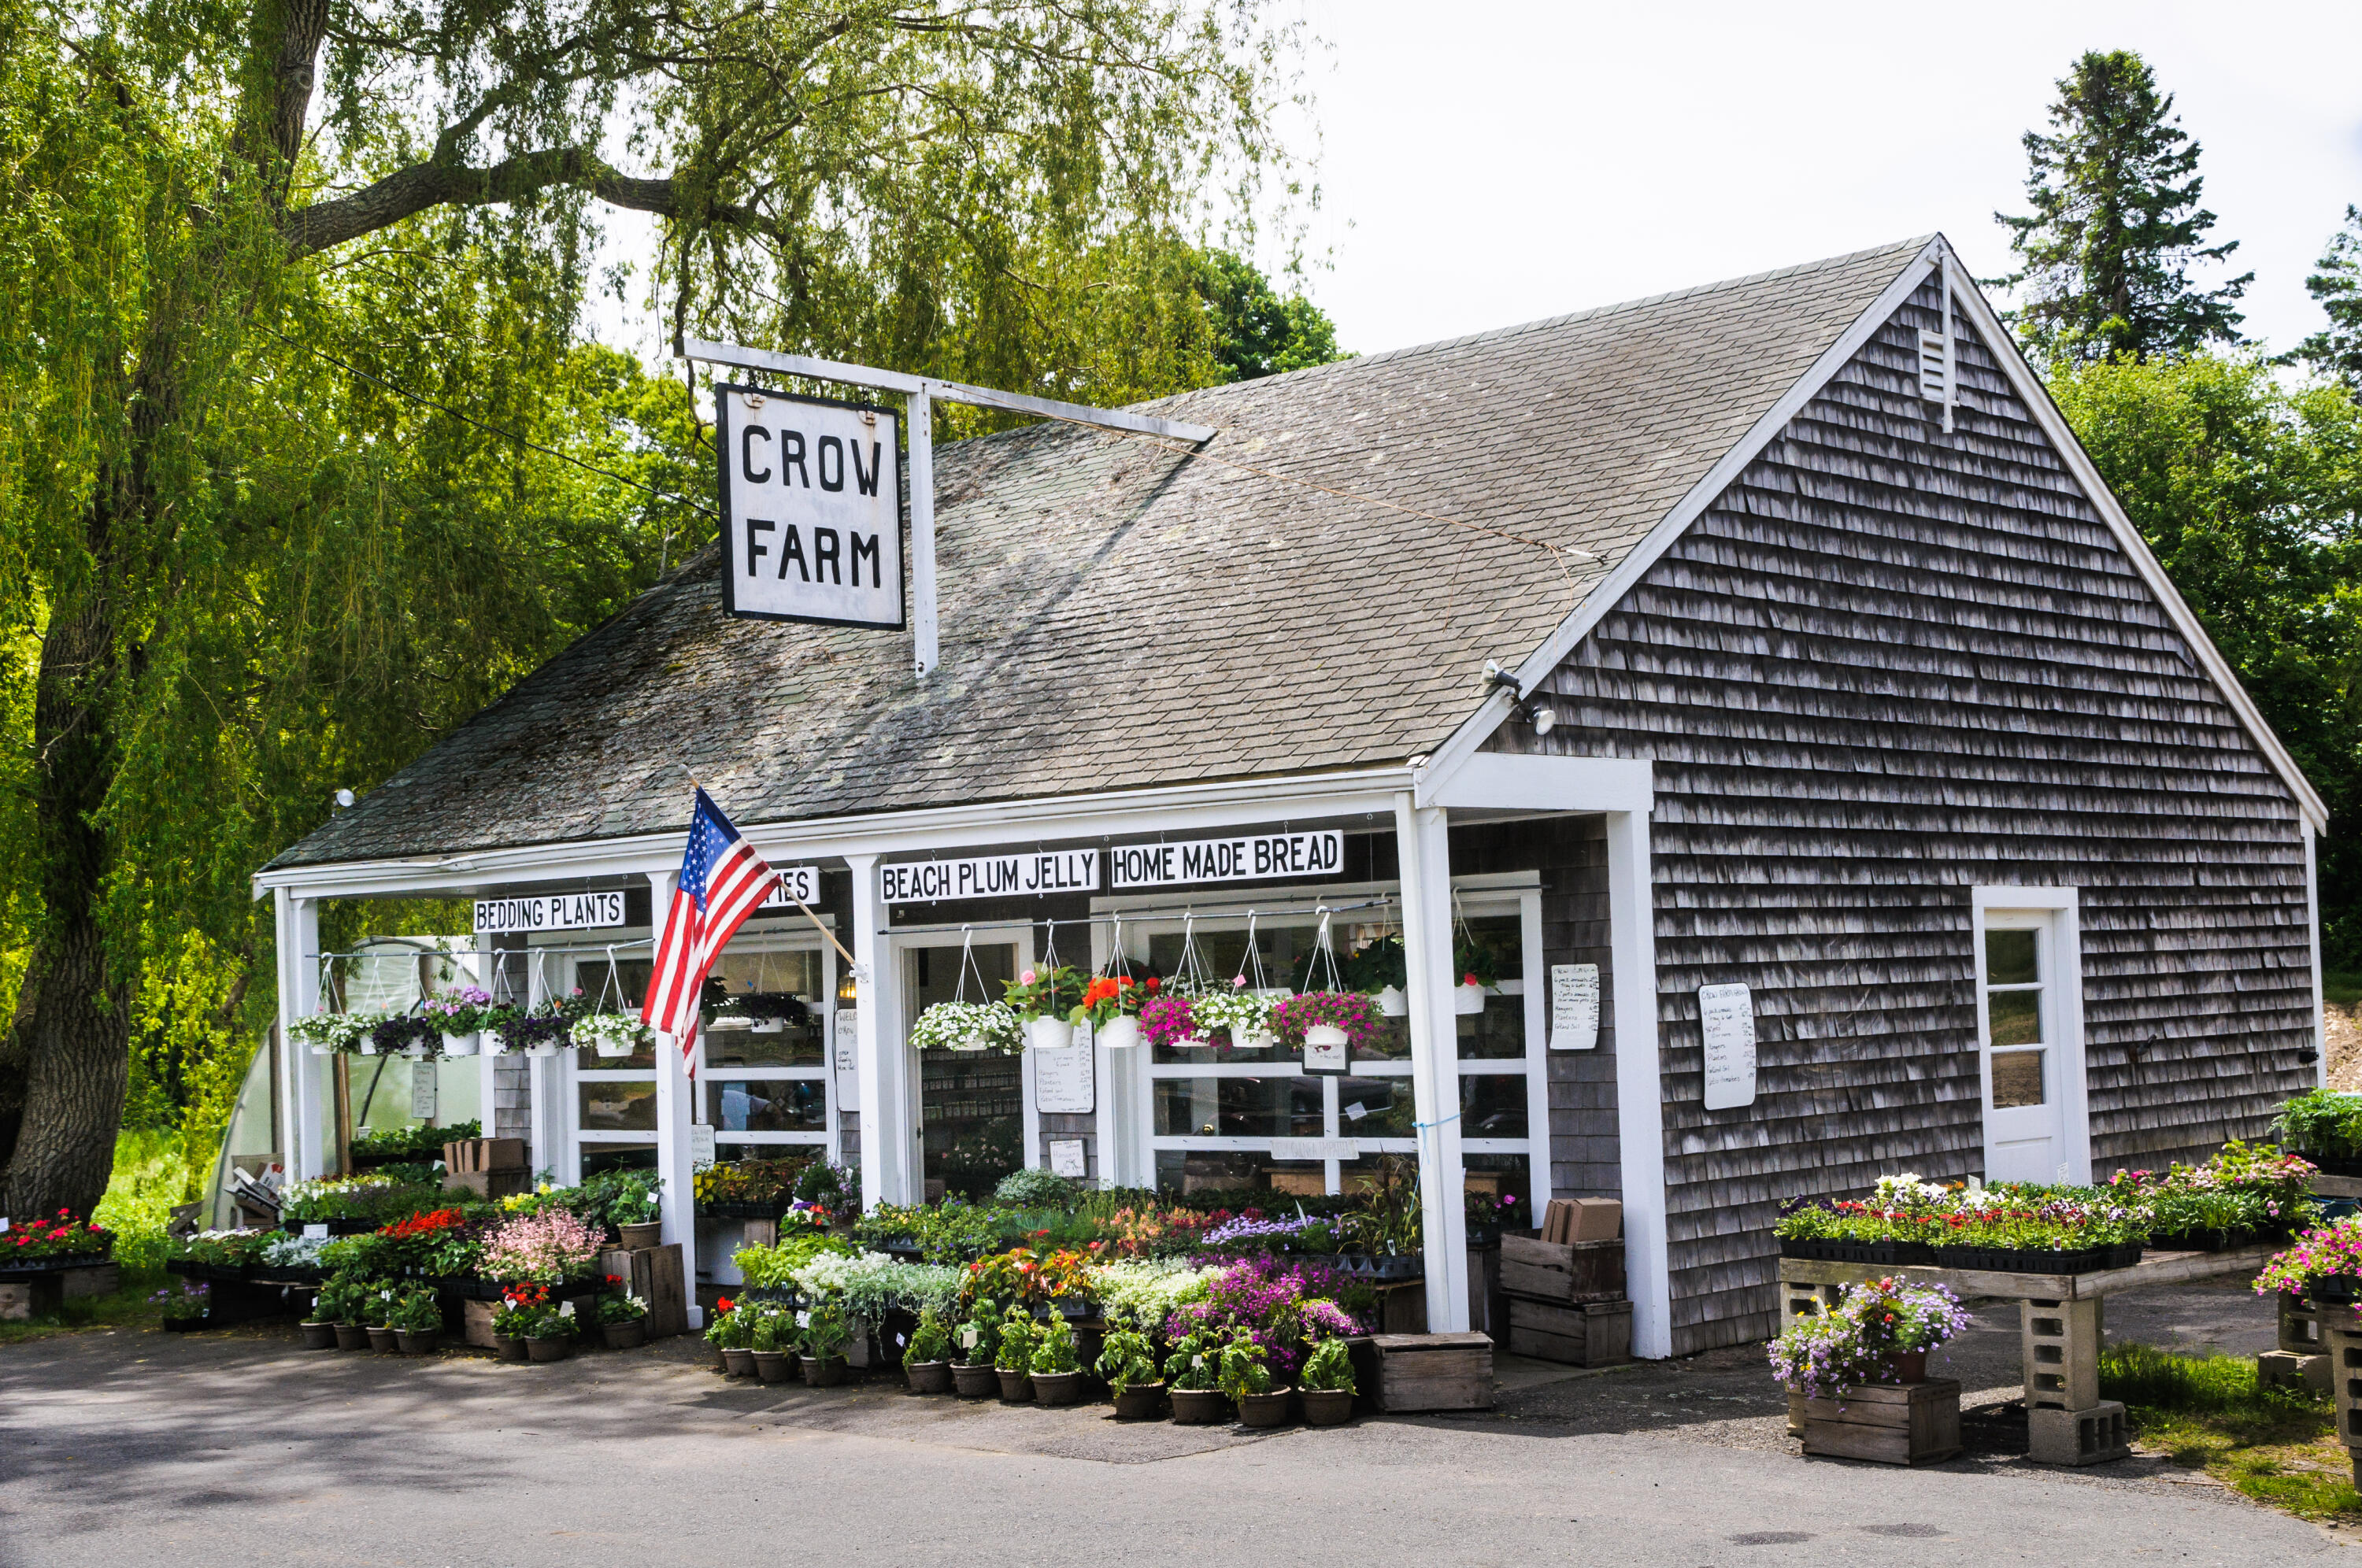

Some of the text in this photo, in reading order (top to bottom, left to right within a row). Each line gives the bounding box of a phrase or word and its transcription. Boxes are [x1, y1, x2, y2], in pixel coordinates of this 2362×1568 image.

[742, 424, 881, 497] CROW
[747, 518, 880, 588] FARM
[883, 853, 1094, 900] BEACH PLUM JELLY
[1113, 834, 1337, 883] HOME MADE BREAD
[476, 894, 620, 930] BEDDING PLANTS
